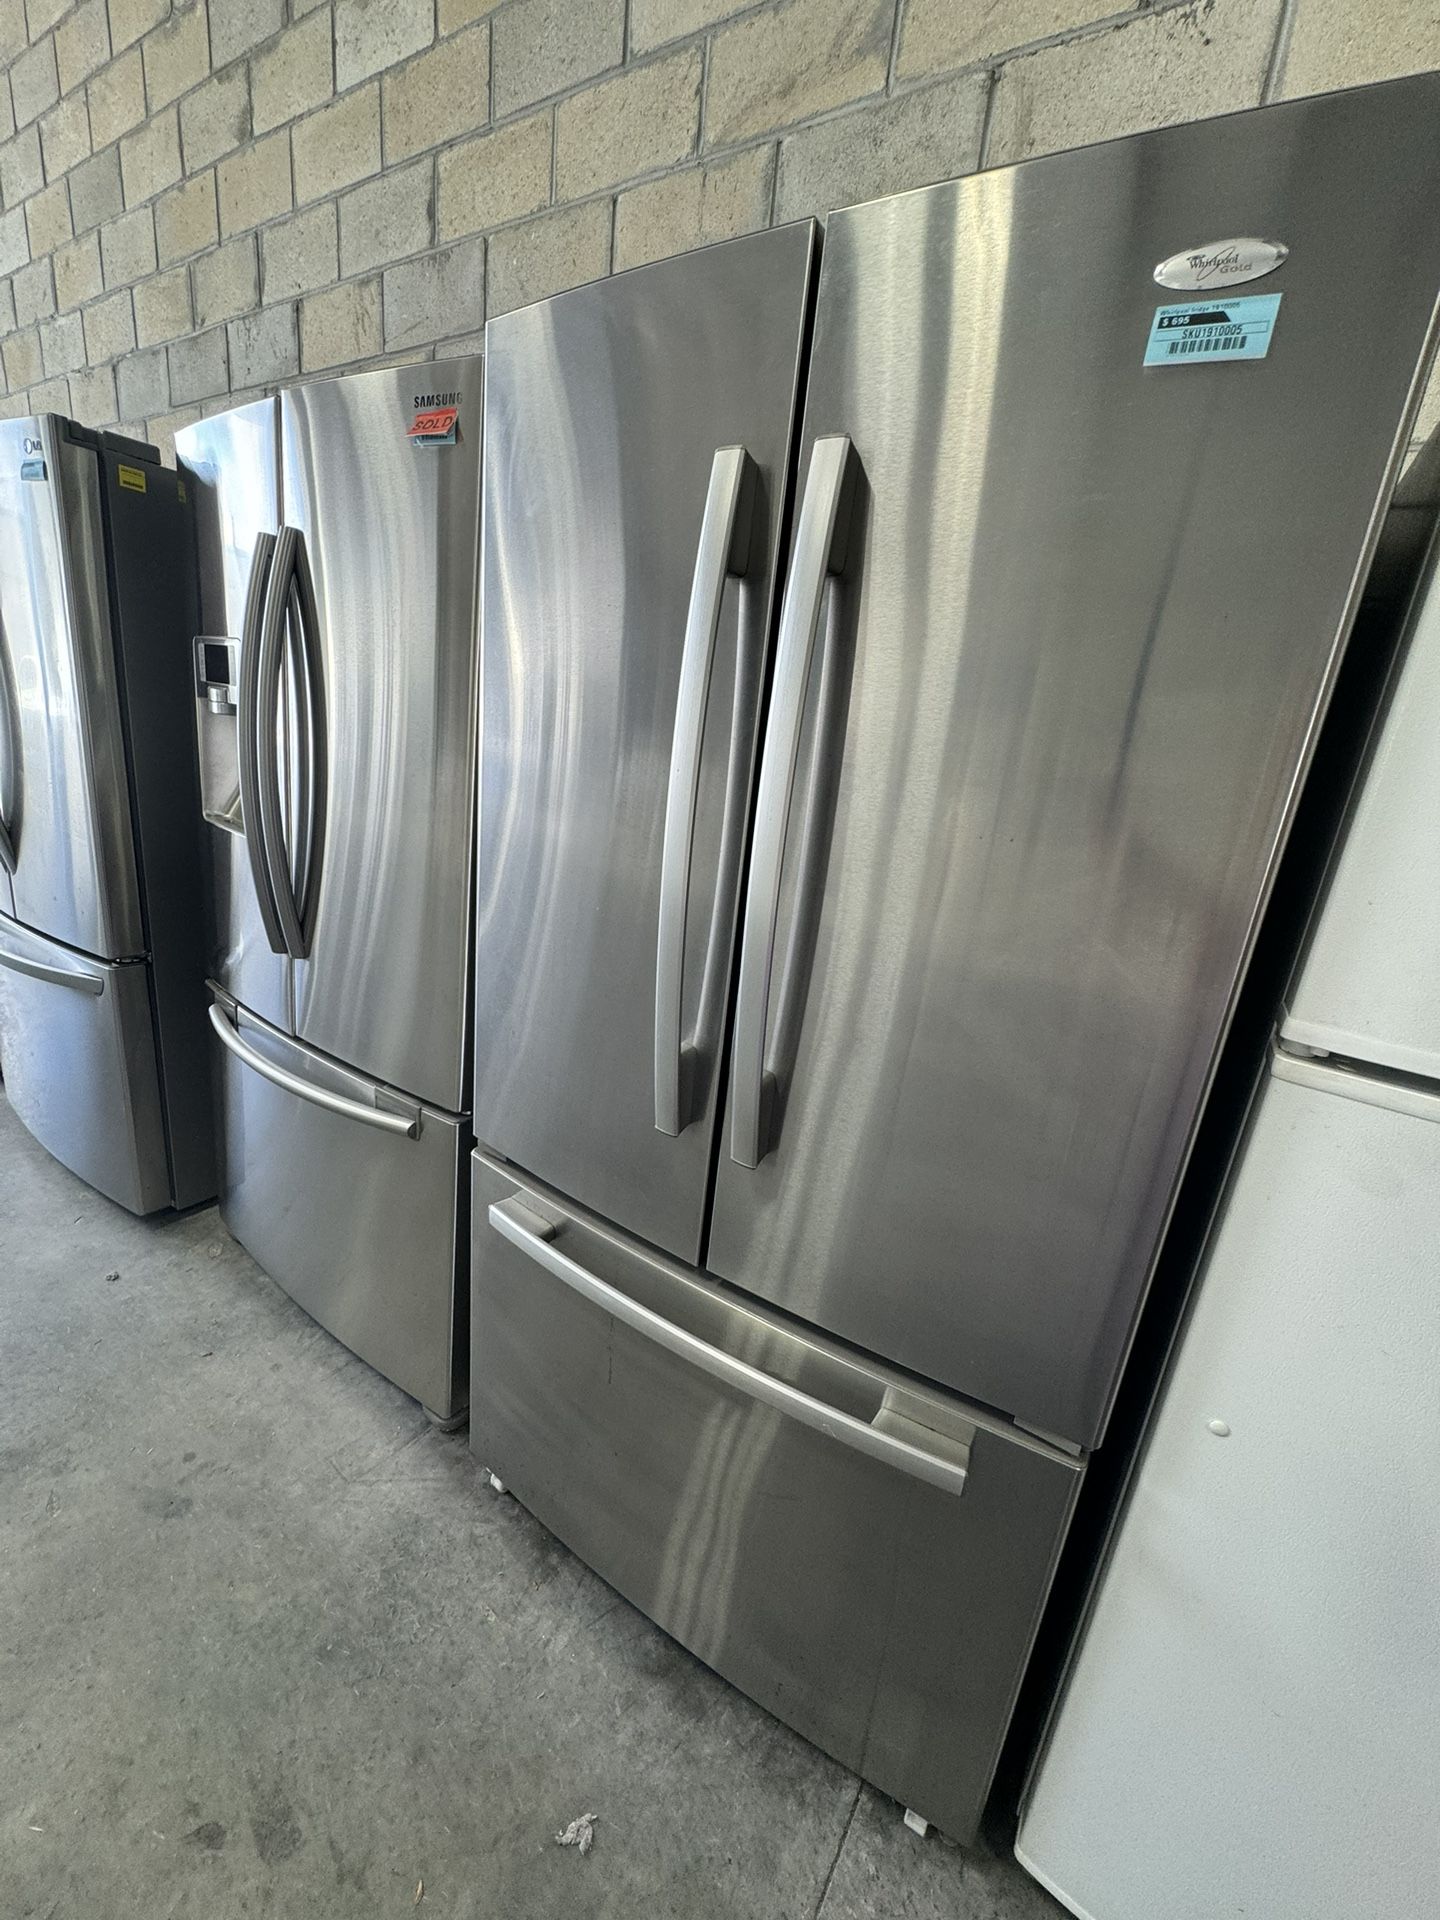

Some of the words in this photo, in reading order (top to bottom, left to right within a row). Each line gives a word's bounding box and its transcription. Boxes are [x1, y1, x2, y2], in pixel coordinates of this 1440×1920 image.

[1187, 253, 1239, 270] Whirlpool
[1162, 316, 1169, 327] $
[1171, 315, 1190, 326] 695
[1182, 324, 1243, 340] SKU1910005
[414, 392, 463, 408] SAMSUNG
[412, 416, 453, 430] SOLD
